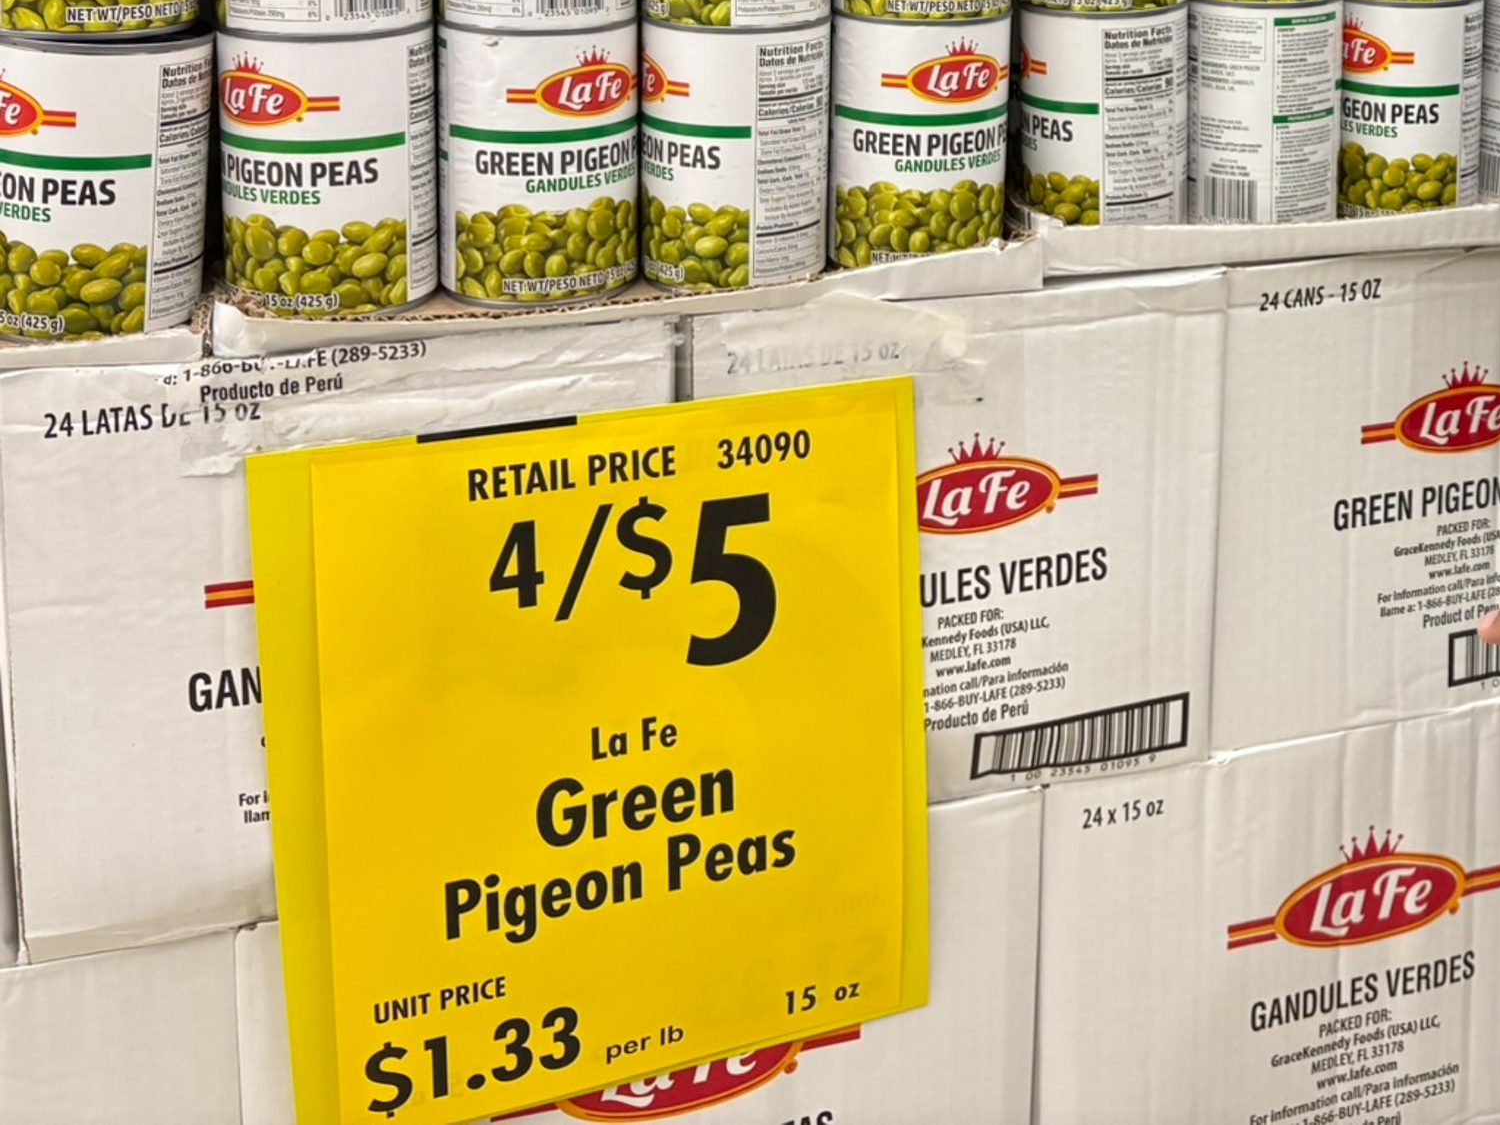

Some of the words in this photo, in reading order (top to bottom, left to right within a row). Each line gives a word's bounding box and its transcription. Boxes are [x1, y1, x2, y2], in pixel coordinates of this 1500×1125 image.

[67, 7, 94, 22] NET
[97, 5, 152, 23] WT/PESO
[1391, 103, 1439, 124] PEAS
[1355, 122, 1398, 138] VERDES
[476, 150, 554, 176] GREEN
[561, 138, 630, 175] PIGEON
[667, 141, 721, 170] PEAS
[225, 158, 303, 191] PIGEON
[311, 158, 378, 187] PEAS
[526, 173, 602, 193] GANDULES
[42, 178, 116, 206] PEAS
[260, 189, 321, 205] VERDES
[265, 295, 278, 309] 15
[280, 296, 293, 309] oz
[295, 293, 324, 310] (425
[326, 293, 339, 311] g)
[1259, 291, 1279, 312] 24
[1283, 285, 1325, 309] CANS
[1340, 282, 1358, 302] 15
[1361, 278, 1382, 300] OZ
[330, 341, 427, 369] (289-5233)
[200, 381, 274, 403] Producto
[279, 378, 300, 396] de
[305, 372, 343, 393] Perú
[44, 412, 74, 439] 24
[82, 404, 153, 436] LATAS
[235, 402, 261, 421] OZ
[468, 458, 576, 502] RETAIL
[588, 445, 676, 486] PRICE
[717, 429, 810, 469] 34090
[1334, 489, 1413, 531] GREEN
[1436, 521, 1469, 536] PACKED
[1471, 518, 1491, 531] FOR:
[1394, 538, 1456, 557] GraceKennedy
[1458, 536, 1482, 551] Foods
[1424, 551, 1458, 566] MEDLEY,
[1459, 549, 1469, 560] FL
[1470, 544, 1495, 559] 33178
[490, 493, 776, 666] 4/$5
[999, 547, 1107, 595] VERDES
[1428, 561, 1490, 579] www.lafe.com
[937, 612, 977, 630] PACKED
[980, 607, 1004, 623] FOR:
[969, 625, 999, 641] Foods
[1000, 619, 1028, 636] (USA)
[1030, 616, 1050, 630] LLC,
[1422, 608, 1462, 629] Product
[1464, 605, 1475, 621] of
[930, 645, 971, 663] MEDLEY,
[973, 643, 984, 656] FL
[987, 637, 1017, 654] 33178
[935, 656, 1014, 681] www.lafe.com
[982, 707, 997, 723] de
[1001, 699, 1029, 720] Perú
[591, 727, 627, 760] La
[642, 716, 677, 751] Fe
[536, 769, 734, 847] Green
[1082, 806, 1103, 829] 24
[1107, 808, 1117, 825] x
[1123, 799, 1141, 822] 15
[1146, 799, 1164, 817] oz
[445, 861, 642, 944] Pigeon
[668, 830, 795, 891] Peas
[374, 993, 431, 1024] UNIT
[440, 976, 506, 1010] PRICE
[786, 985, 816, 1015] 15
[834, 983, 859, 1001] oz
[1251, 973, 1379, 1032] GANDULES
[1386, 950, 1475, 997] VERDES
[1319, 1014, 1363, 1038] PACKED
[1365, 1008, 1392, 1027] FOR:
[1271, 1036, 1352, 1068] GraceKennedy
[1353, 1027, 1385, 1046] Foods
[1387, 1020, 1418, 1039] (USA)
[1419, 1015, 1441, 1031] LLC,
[365, 1006, 582, 1117] $1.33
[604, 1040, 651, 1065] per
[660, 1025, 684, 1046] lb
[1311, 1053, 1354, 1076] MEDLEY,
[1357, 1048, 1369, 1062] FL
[1371, 1040, 1404, 1059] 33178
[1316, 1061, 1399, 1091] www.lafe.com
[1394, 1078, 1455, 1107] (289-5233)
